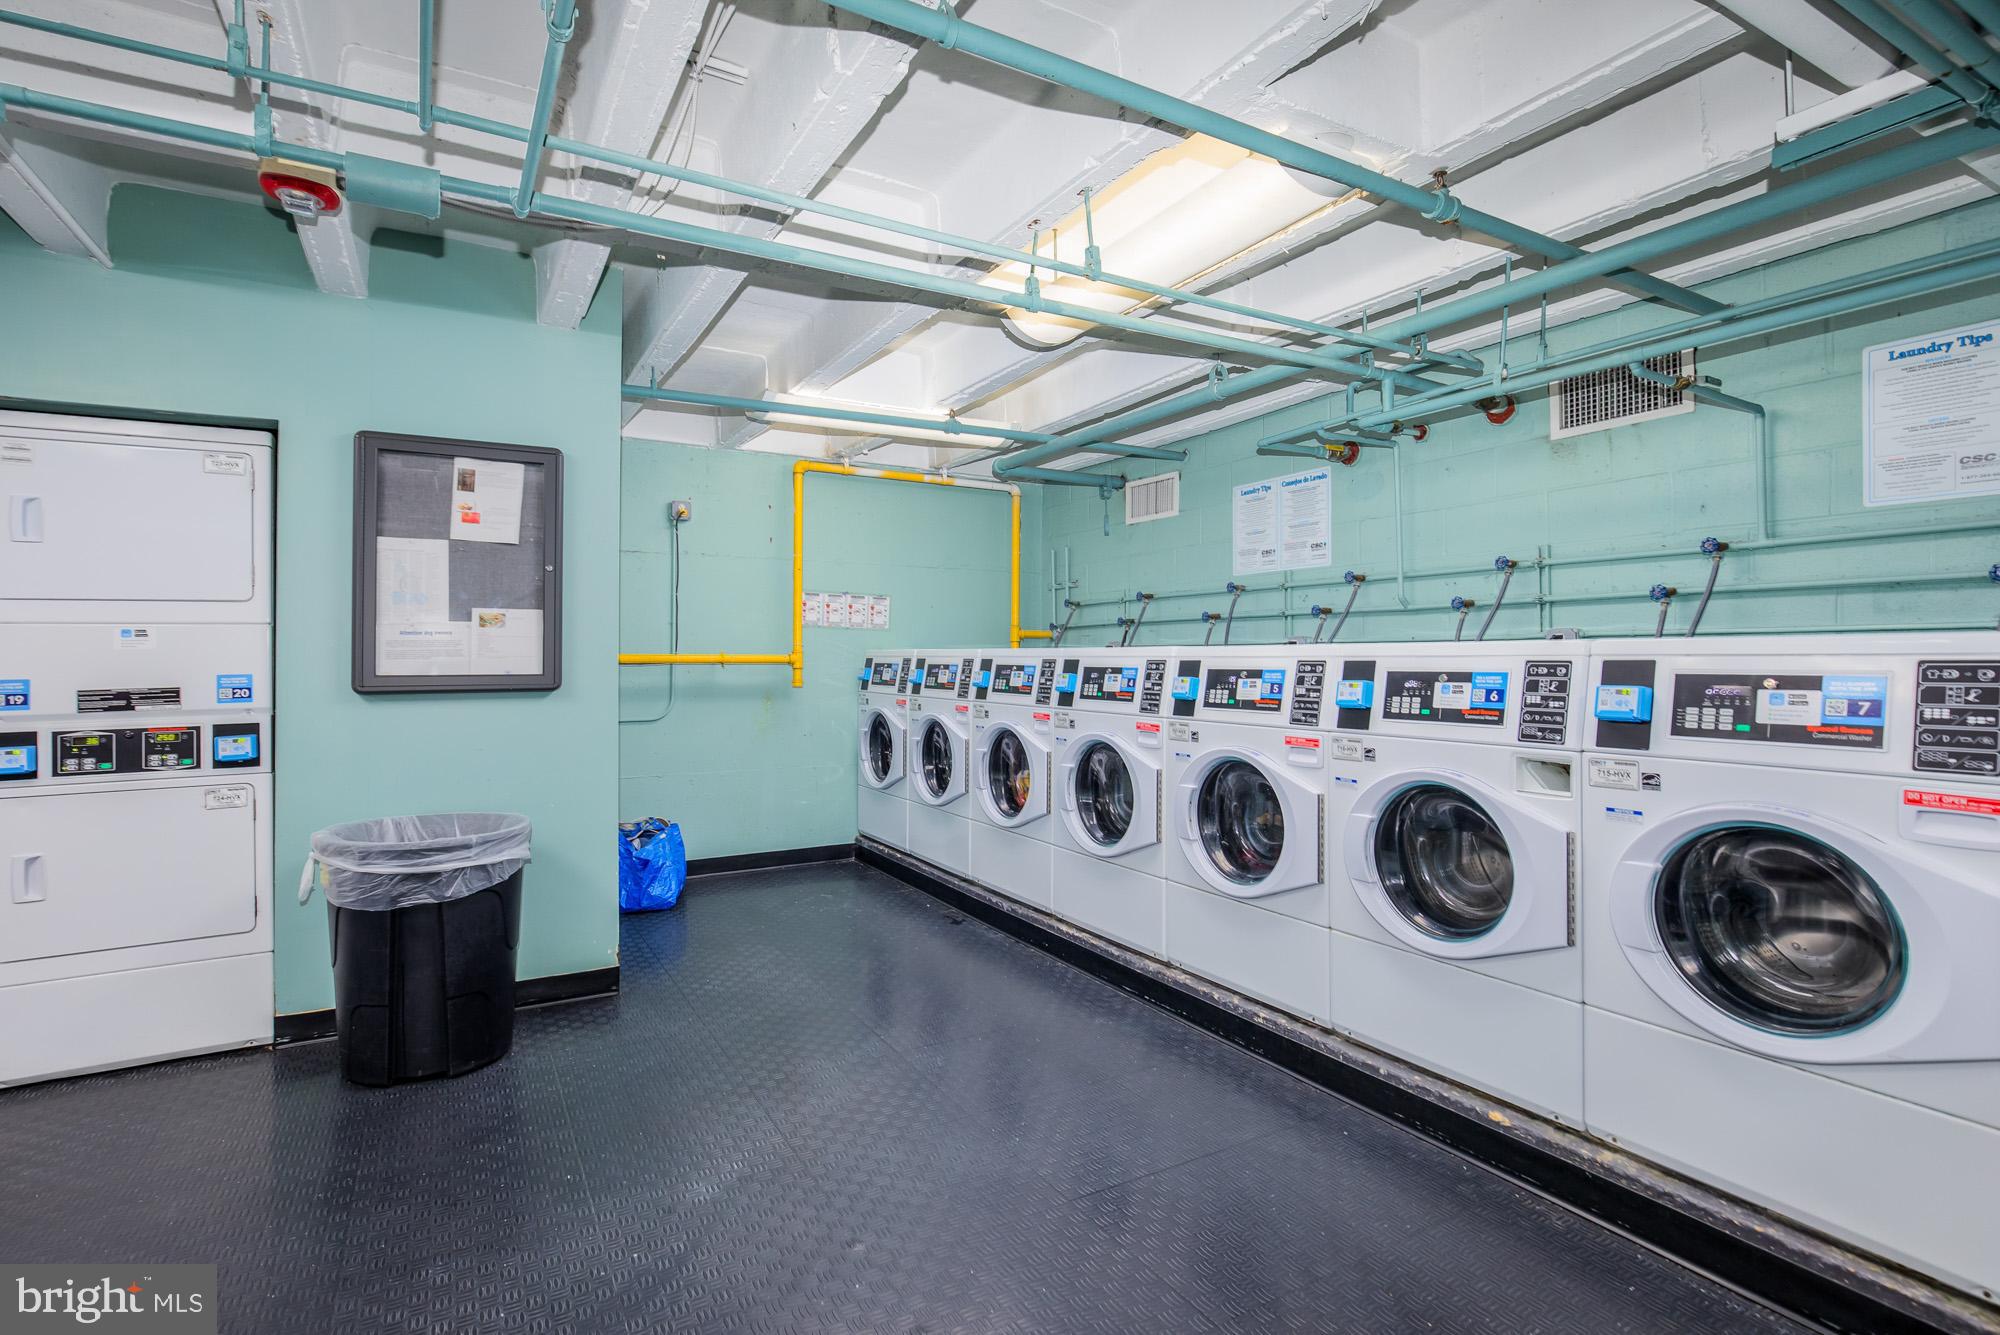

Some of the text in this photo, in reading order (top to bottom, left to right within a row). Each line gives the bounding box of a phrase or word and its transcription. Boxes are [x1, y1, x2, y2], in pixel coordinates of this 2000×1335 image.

[1888, 333, 1993, 362] Laundry Tips
[1960, 453, 1997, 464] CSC
[1241, 485, 1271, 497] Laundry Tips
[233, 688, 250, 698] 20
[1272, 684, 1279, 693] 5
[7, 695, 25, 705] 19
[1490, 690, 1499, 702] 6
[1858, 701, 1872, 716] 7
[1812, 732, 1873, 743] Commercial Washer
[1907, 792, 1968, 806] DO NOT OPEN
